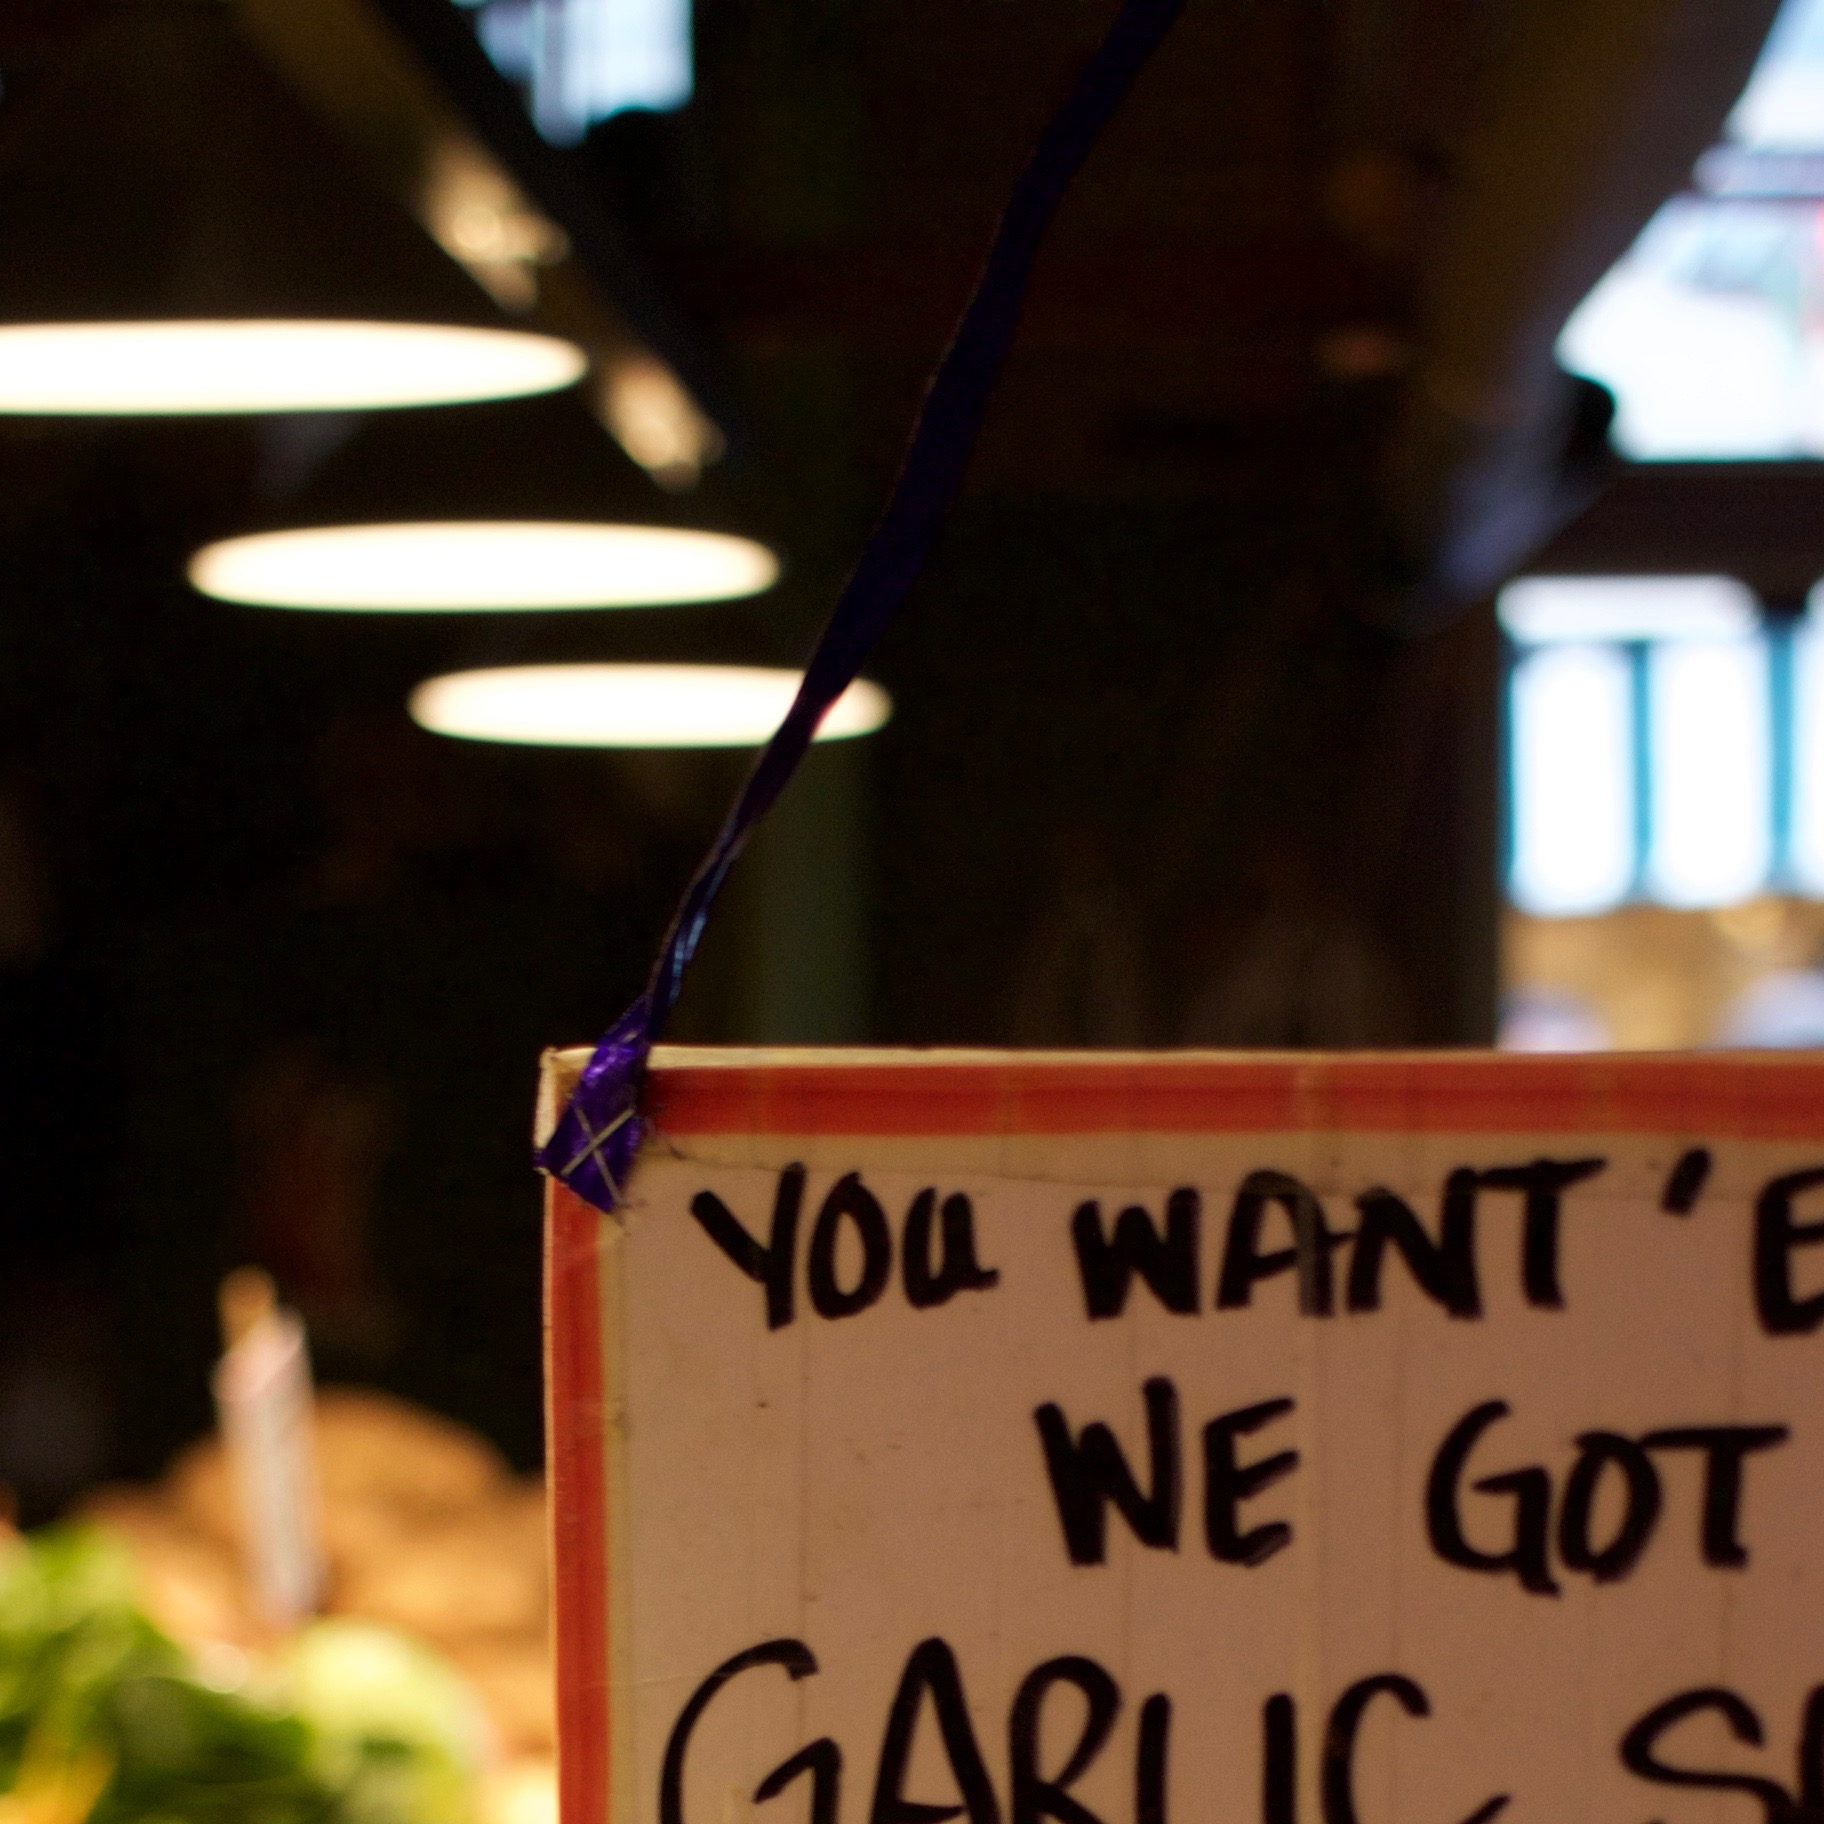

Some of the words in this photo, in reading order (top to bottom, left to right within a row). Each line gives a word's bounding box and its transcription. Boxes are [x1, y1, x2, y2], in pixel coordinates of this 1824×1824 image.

[1070, 1157, 1607, 1320] WANT
[1032, 1376, 1299, 1567] WE
[1423, 1399, 1789, 1597] GOT
